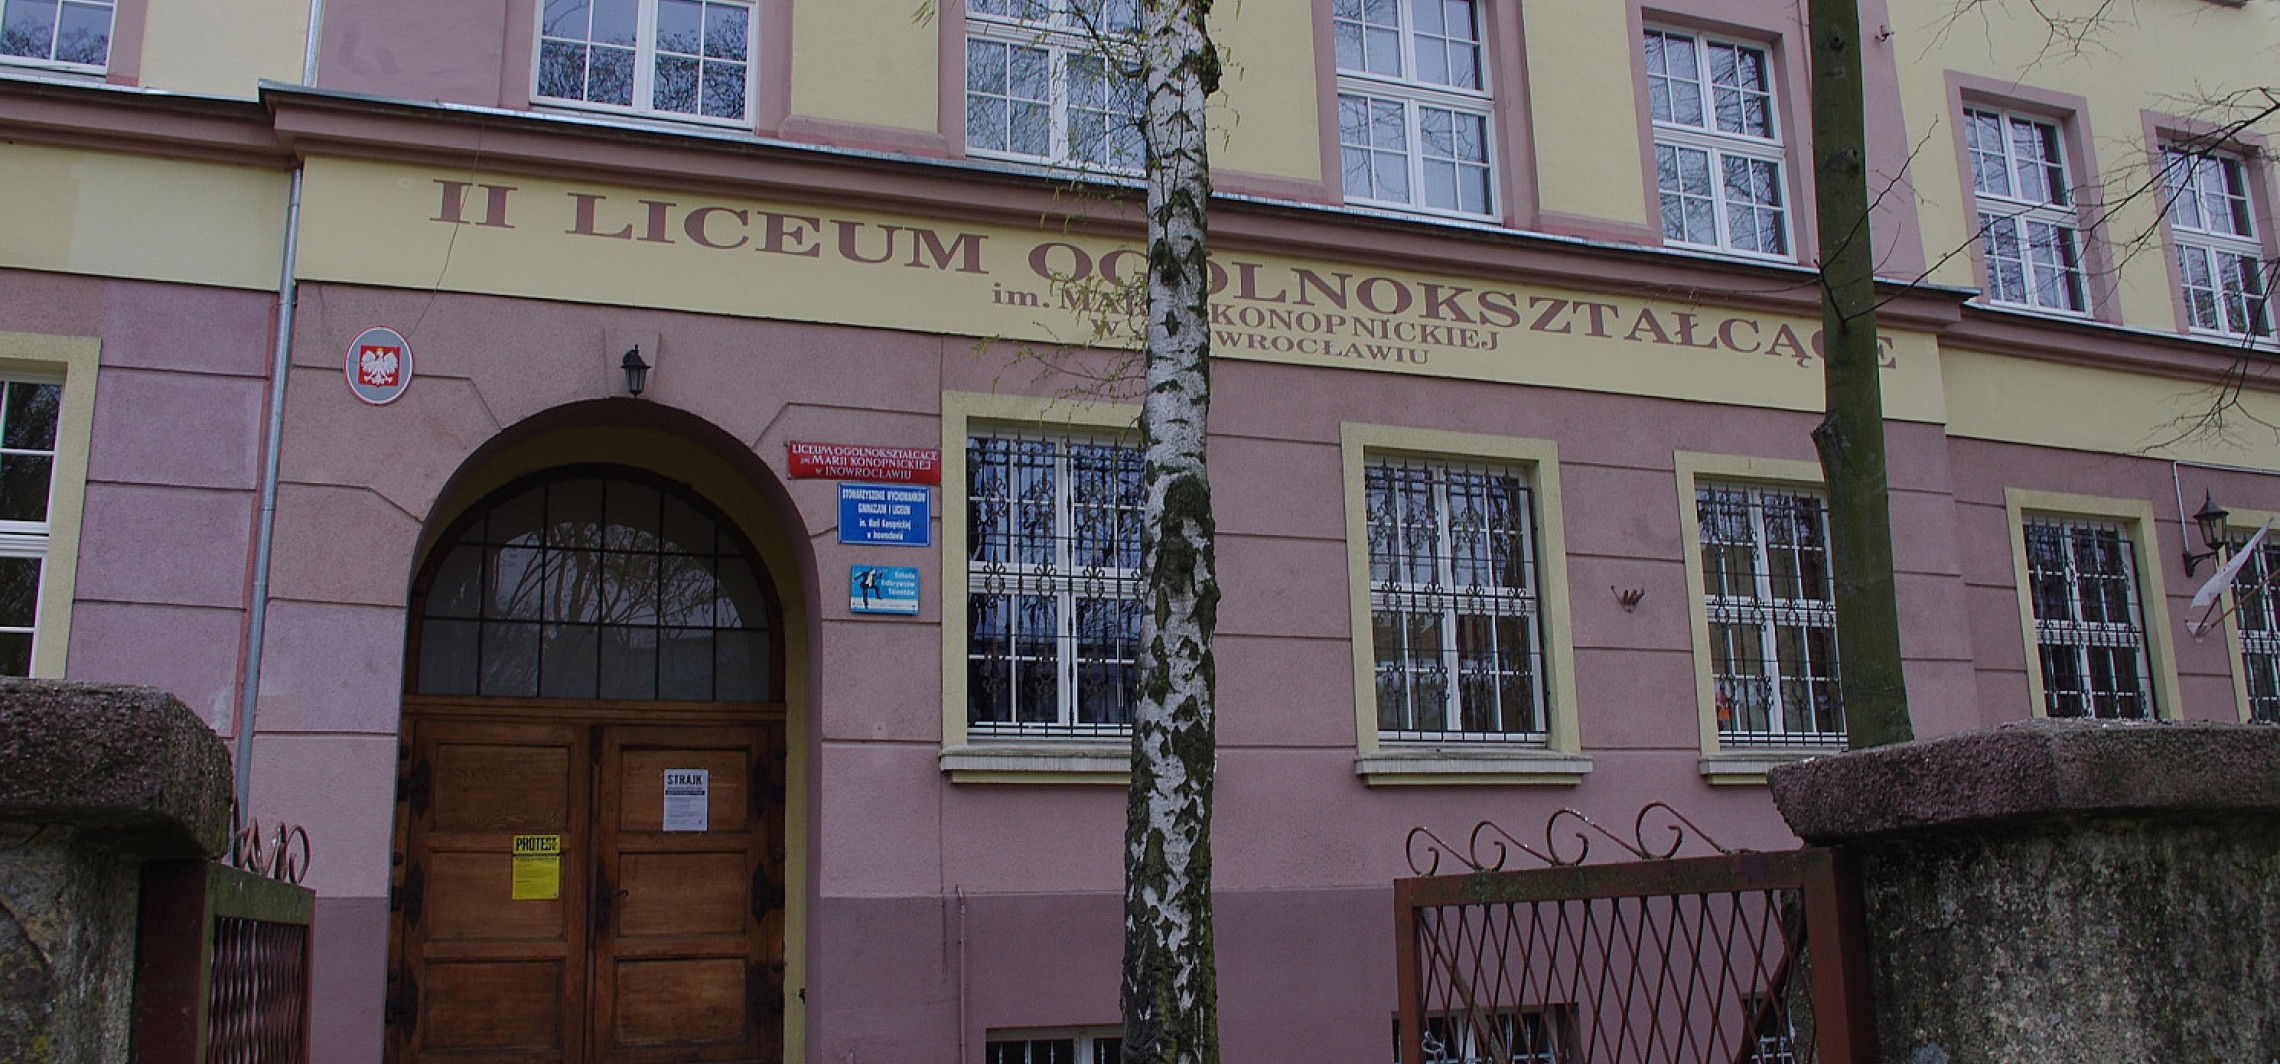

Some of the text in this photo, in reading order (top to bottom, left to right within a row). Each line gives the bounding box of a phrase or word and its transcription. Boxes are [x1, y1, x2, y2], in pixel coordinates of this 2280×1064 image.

[430, 179, 517, 228] II
[565, 191, 990, 275] LICEUM
[992, 282, 1050, 309] im.
[1210, 302, 1499, 351] KONOPNICKIEJ
[792, 443, 832, 456] LICEUM
[812, 455, 847, 466] MARII
[850, 456, 931, 471] KONOPNICKIEJ
[667, 774, 703, 785] STRAJK
